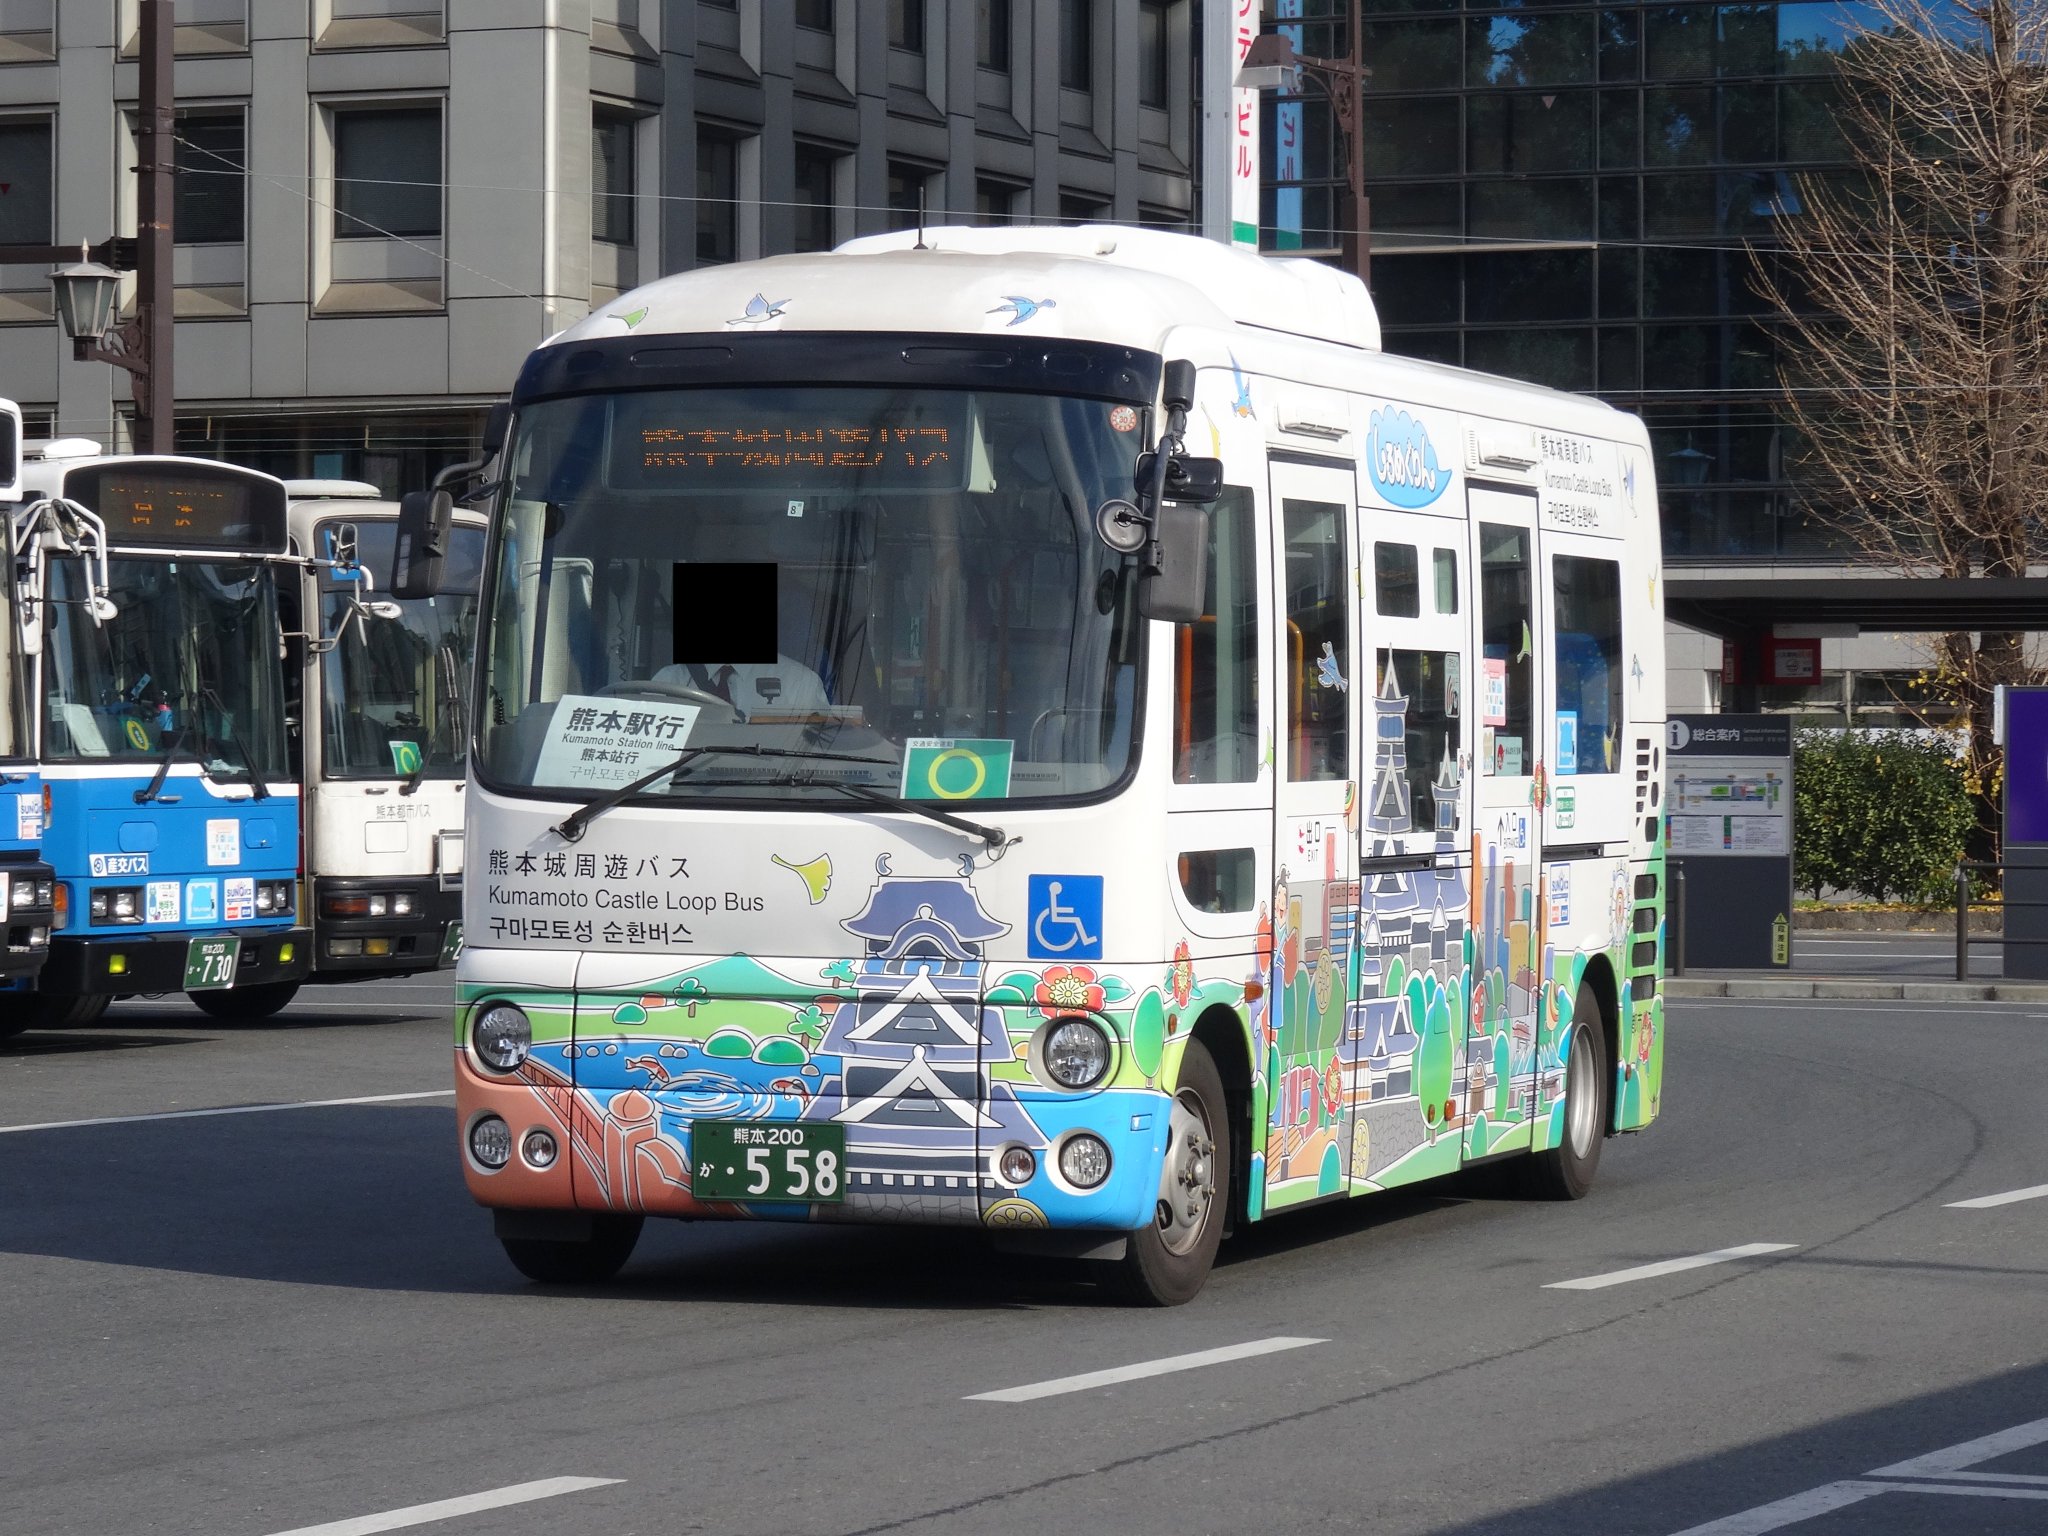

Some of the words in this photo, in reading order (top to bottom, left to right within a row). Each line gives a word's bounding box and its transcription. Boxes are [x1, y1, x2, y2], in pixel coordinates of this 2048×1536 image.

[1237, 0, 1252, 178] テビル
[566, 707, 686, 739] 熊本駅行
[562, 733, 614, 746] Kumamoto
[617, 737, 653, 750] Station
[656, 738, 675, 751] line
[1692, 728, 1740, 742] 総合案内
[580, 748, 640, 765] 熊本站行
[376, 804, 431, 820] 熊本都市バス
[1504, 811, 1517, 832] 入口
[1306, 820, 1321, 844] 出口
[488, 849, 691, 880] 熊本城周遊バス
[1307, 848, 1319, 862] EXIT
[107, 857, 148, 874] 産交バス
[489, 885, 589, 908] Kumamoto
[595, 888, 659, 910] Castle
[666, 890, 717, 915] Loop
[725, 892, 765, 912] Bus
[489, 916, 594, 943] 구마모토성
[602, 920, 694, 945] 순환버스
[733, 1127, 804, 1146] 熊本200
[699, 1162, 715, 1178] か
